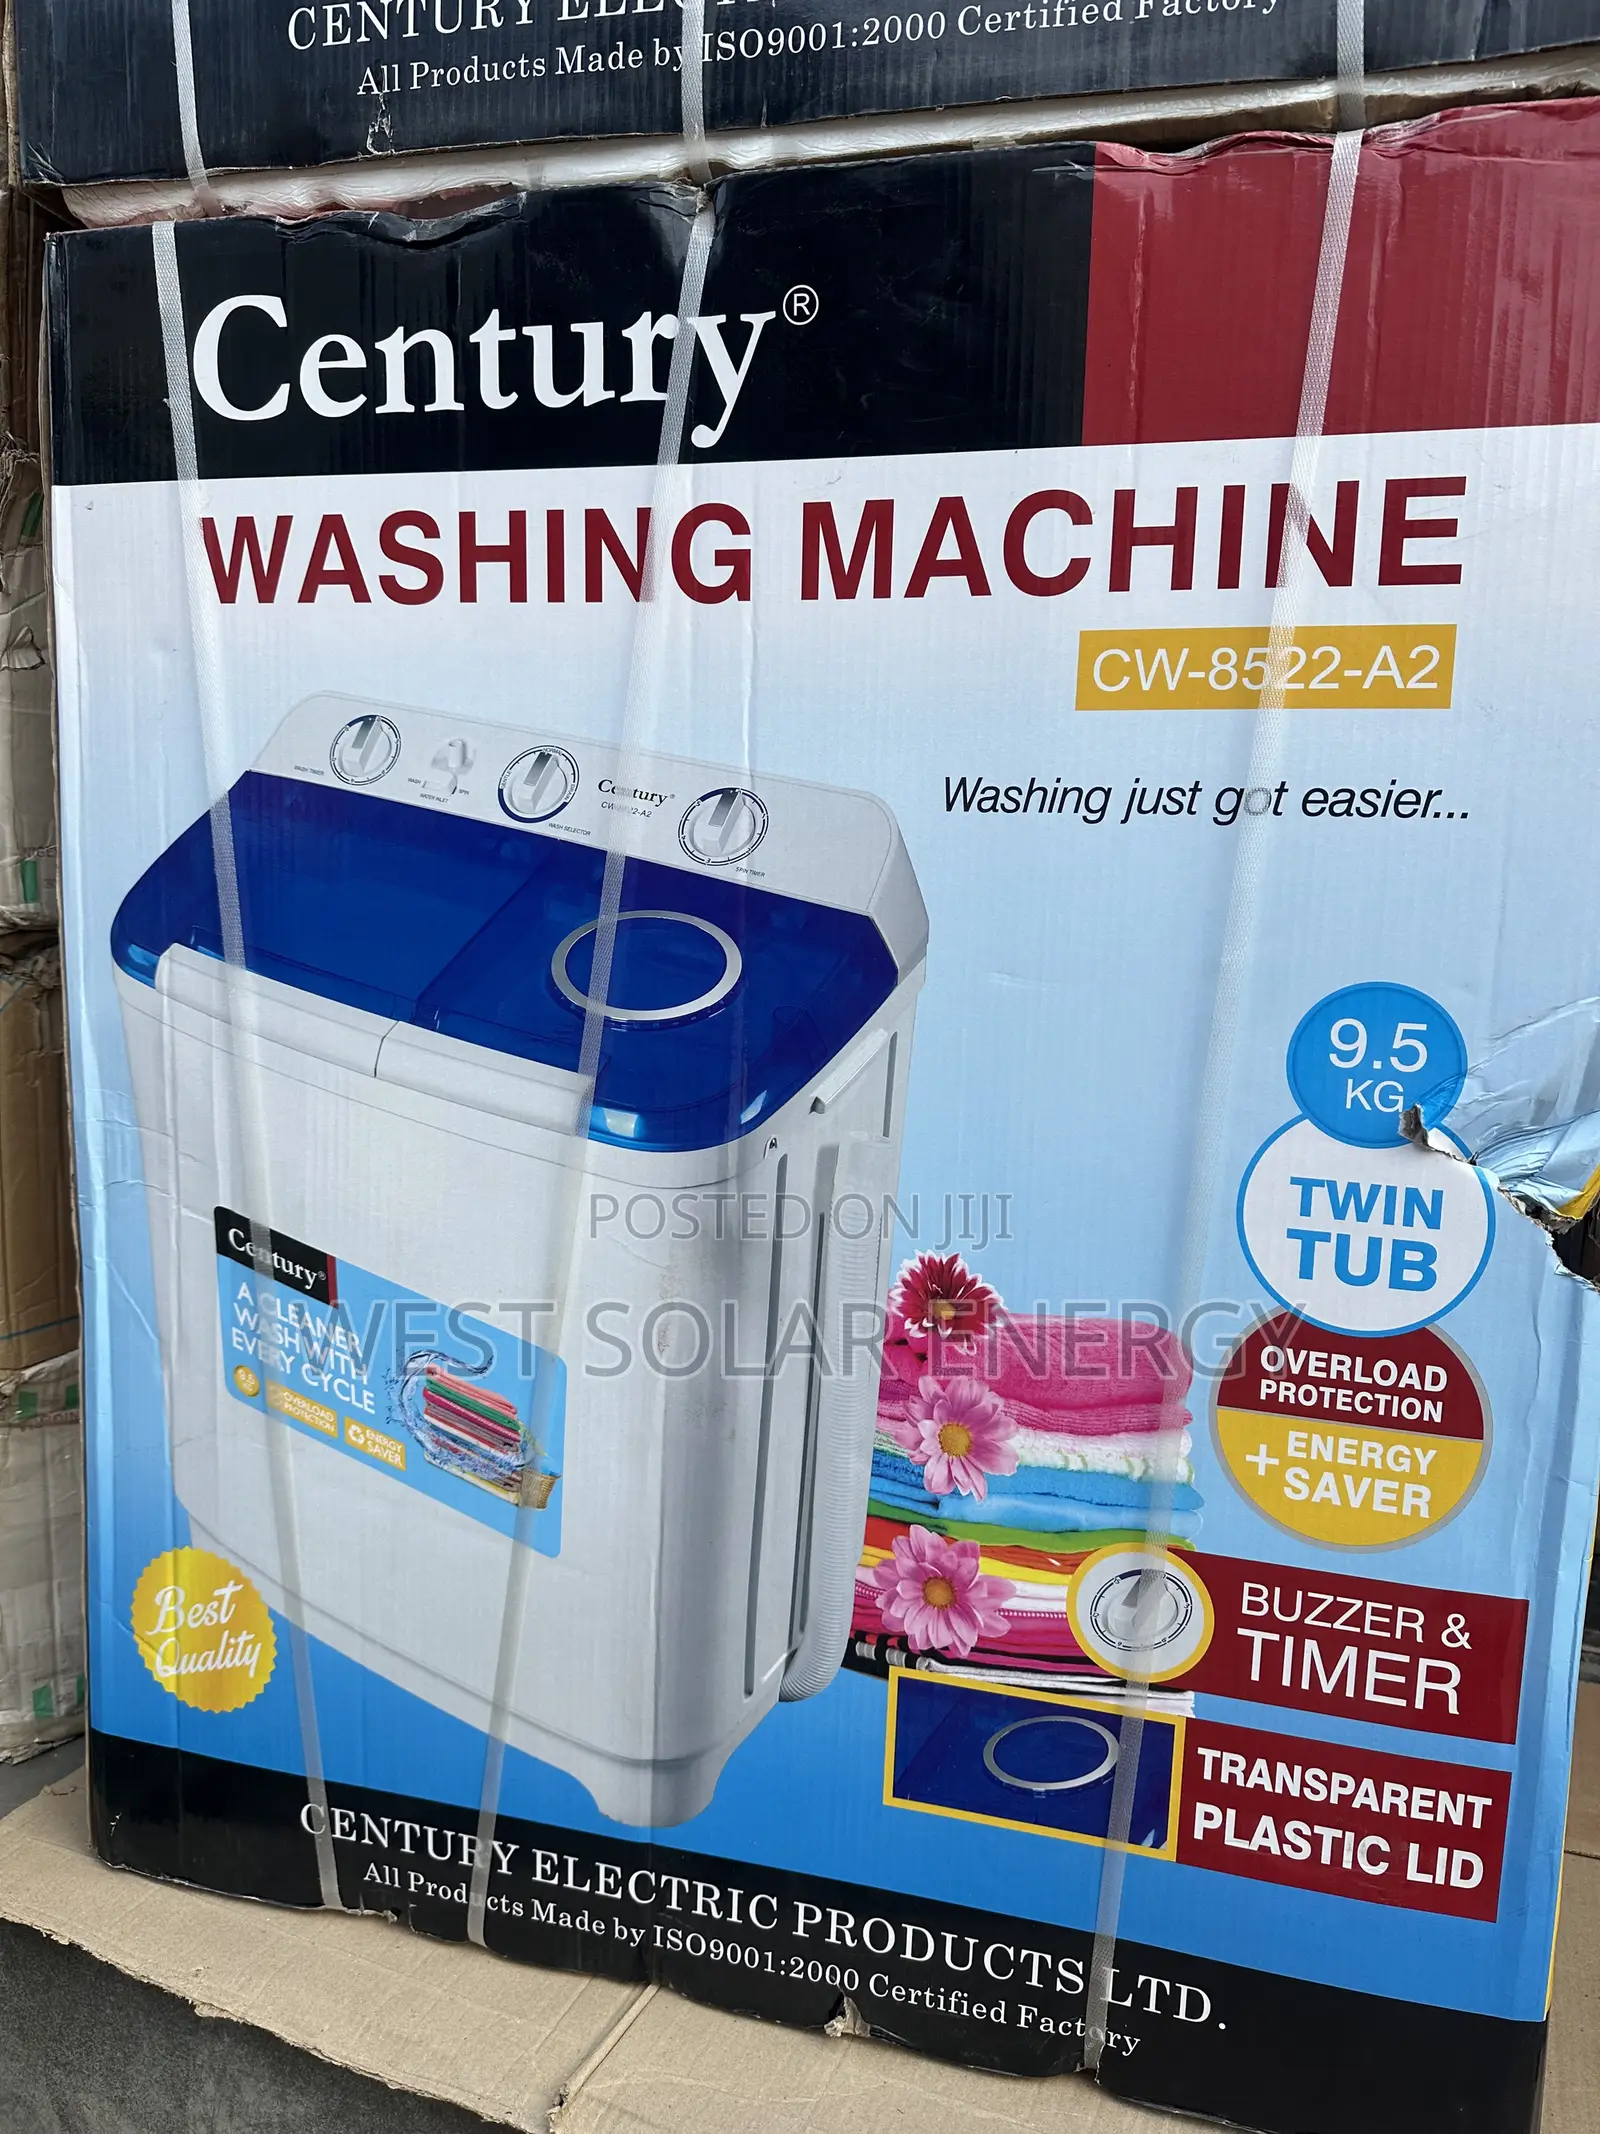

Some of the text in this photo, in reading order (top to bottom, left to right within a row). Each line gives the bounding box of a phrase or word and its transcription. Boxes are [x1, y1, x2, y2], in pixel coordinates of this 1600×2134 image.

[357, 63, 401, 95] All
[410, 54, 546, 90] Products
[555, 41, 643, 75] Made
[701, 11, 946, 62] ISO9001:2000
[957, 0, 1123, 36] Certified
[200, 502, 752, 605] WASHING
[800, 476, 1467, 600] MACHINE
[1092, 645, 1440, 692] CW-8522-A2
[944, 777, 1469, 826] Washing just got easier...
[1329, 1018, 1428, 1072] 9.5
[1345, 1078, 1405, 1113] KG
[1289, 1176, 1444, 1230] TWIN
[1286, 1228, 1438, 1292] TUB
[237, 1282, 363, 1358] A CLEANER
[303, 1335, 368, 1385] WITH
[1260, 1345, 1448, 1392] OVERLOAD
[301, 1363, 376, 1415] CYCLE
[1259, 1379, 1444, 1423] PROTECTION
[367, 1440, 403, 1467] SAVER
[1287, 1430, 1437, 1475] ENERGY
[1283, 1467, 1432, 1519] SAVER
[145, 1580, 243, 1636] Best
[1241, 1581, 1472, 1650] BUZZER &
[155, 1630, 262, 1678] Quality
[1237, 1627, 1462, 1715] TIMER
[1197, 1746, 1492, 1829] TRANSPARENT
[1193, 1802, 1484, 1889] PLASTIC LID
[301, 1802, 1228, 2031] CENTURY ELECTRIC PRODUCTS LTD.
[363, 1862, 401, 1889] All
[531, 1899, 606, 1935] Made
[612, 1917, 646, 1947] by
[653, 1925, 859, 1992] ISO9001:2000
[868, 1973, 1007, 2025] Certified
[1017, 2004, 1141, 2057] Factory
